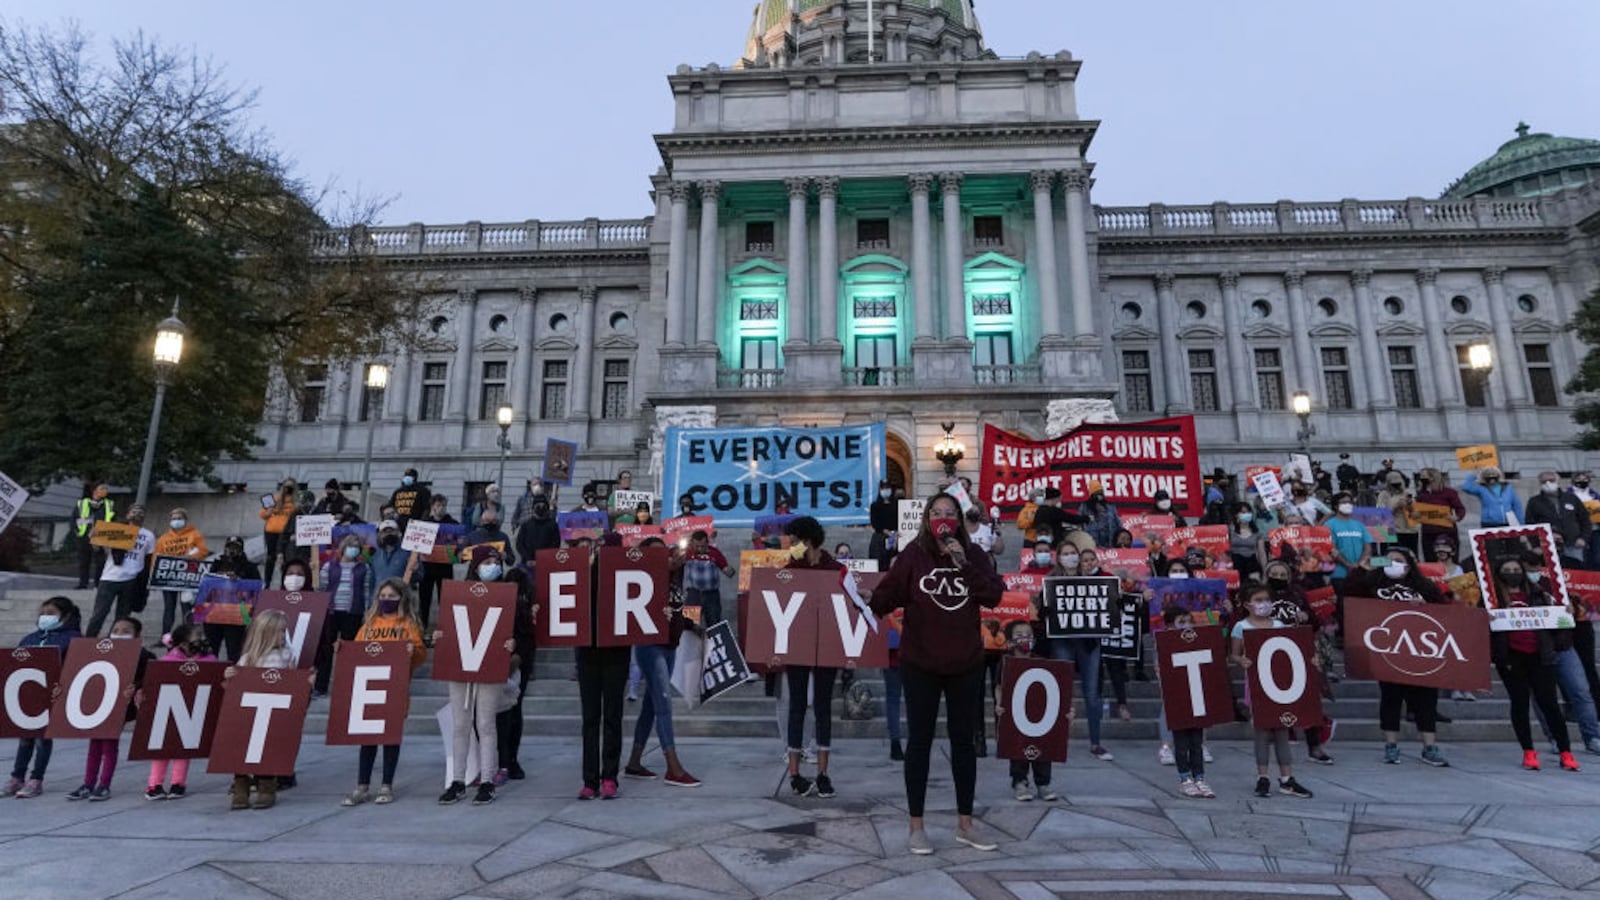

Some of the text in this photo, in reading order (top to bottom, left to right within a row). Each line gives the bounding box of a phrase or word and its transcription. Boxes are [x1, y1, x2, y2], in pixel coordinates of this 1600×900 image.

[689, 434, 861, 463] EVERYONE
[994, 435, 1184, 468] EVERYONE COUNTS
[617, 493, 651, 501] BLACK
[689, 479, 864, 511] COUNTS!
[991, 474, 1062, 503] COUNT
[155, 570, 200, 582] HARRI
[848, 561, 865, 569] HEM
[919, 575, 969, 597] CAS
[1055, 585, 1108, 597] COUNT
[549, 571, 577, 637] E
[614, 570, 659, 635] R
[762, 590, 807, 654] Y
[831, 594, 868, 657] V
[1056, 597, 1108, 611] EVERY
[1058, 613, 1111, 629] VOTE
[452, 605, 503, 671] V
[1363, 626, 1469, 662] CASA
[4, 668, 49, 730] C
[65, 660, 120, 730] O
[348, 665, 392, 735] E
[1171, 649, 1213, 717] T
[1257, 636, 1307, 704] O
[147, 684, 211, 749] N
[240, 692, 292, 764] T
[1012, 668, 1060, 737] O
